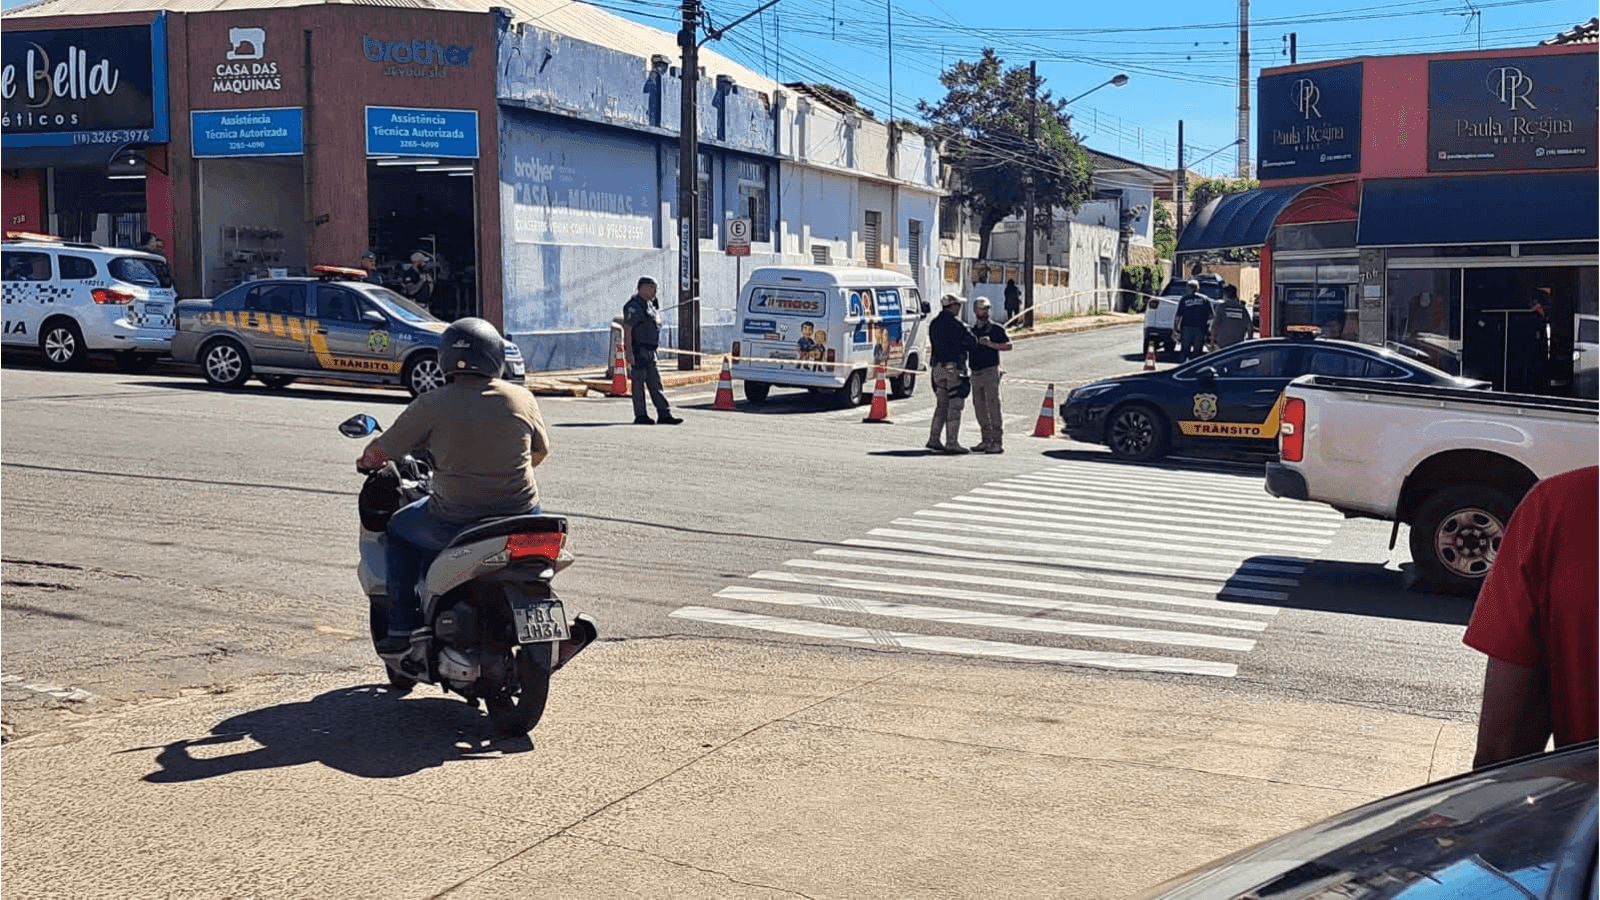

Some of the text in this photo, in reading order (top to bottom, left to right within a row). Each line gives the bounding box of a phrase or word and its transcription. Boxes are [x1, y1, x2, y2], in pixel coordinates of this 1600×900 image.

[363, 32, 474, 69] brother
[25, 41, 119, 107] Bella
[216, 62, 278, 76] CASA DAS
[213, 78, 281, 93] MAQUINAS
[240, 127, 288, 138] Autorizada
[412, 127, 465, 139] Autorizada
[1456, 116, 1574, 139] Paula Regina
[91, 130, 150, 144] 3265-3976
[514, 155, 555, 183] brother
[514, 181, 549, 212] CASA
[735, 223, 741, 234] E
[1, 320, 27, 335] IA
[523, 622, 562, 639] 1H34
